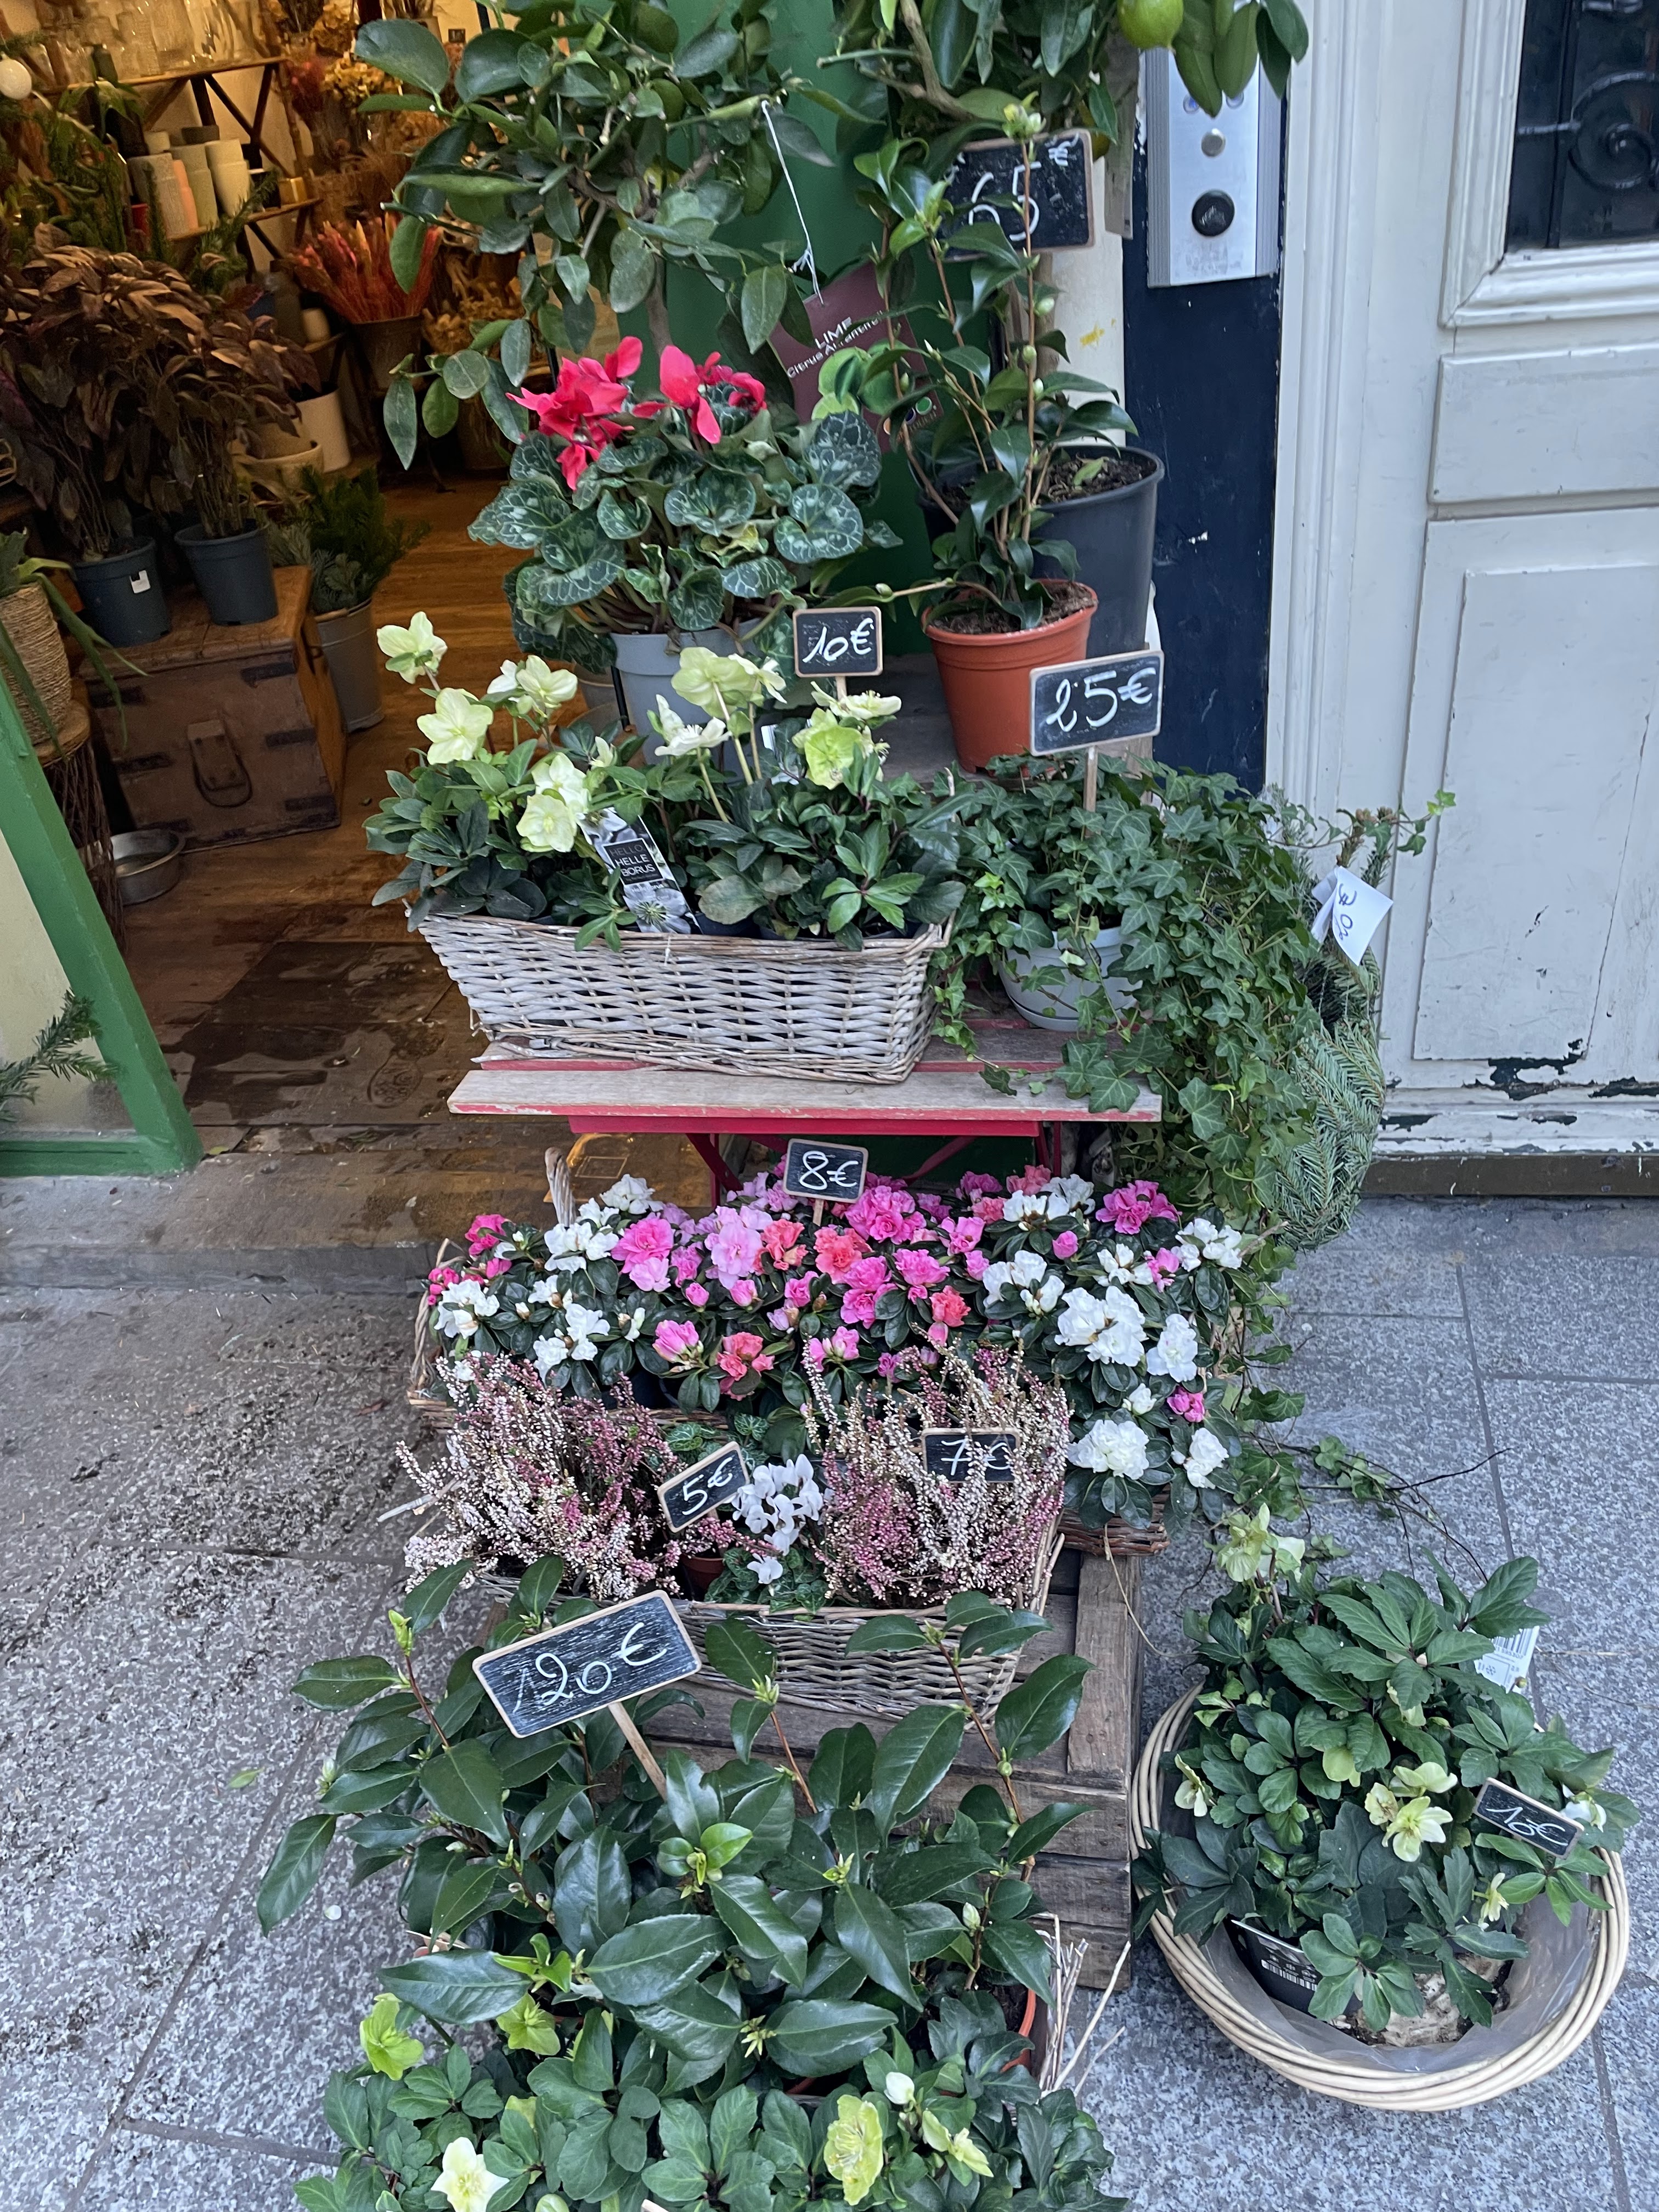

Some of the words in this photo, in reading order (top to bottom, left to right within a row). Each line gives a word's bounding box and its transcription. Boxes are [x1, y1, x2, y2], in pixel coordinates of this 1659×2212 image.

[787, 352, 823, 378] Citrus
[802, 617, 874, 663] 10€
[1046, 667, 1156, 732] 25€
[614, 854, 650, 867] HELLE
[620, 864, 656, 877] BORUS
[799, 1150, 859, 1190] 8€
[682, 1457, 733, 1516] 5€
